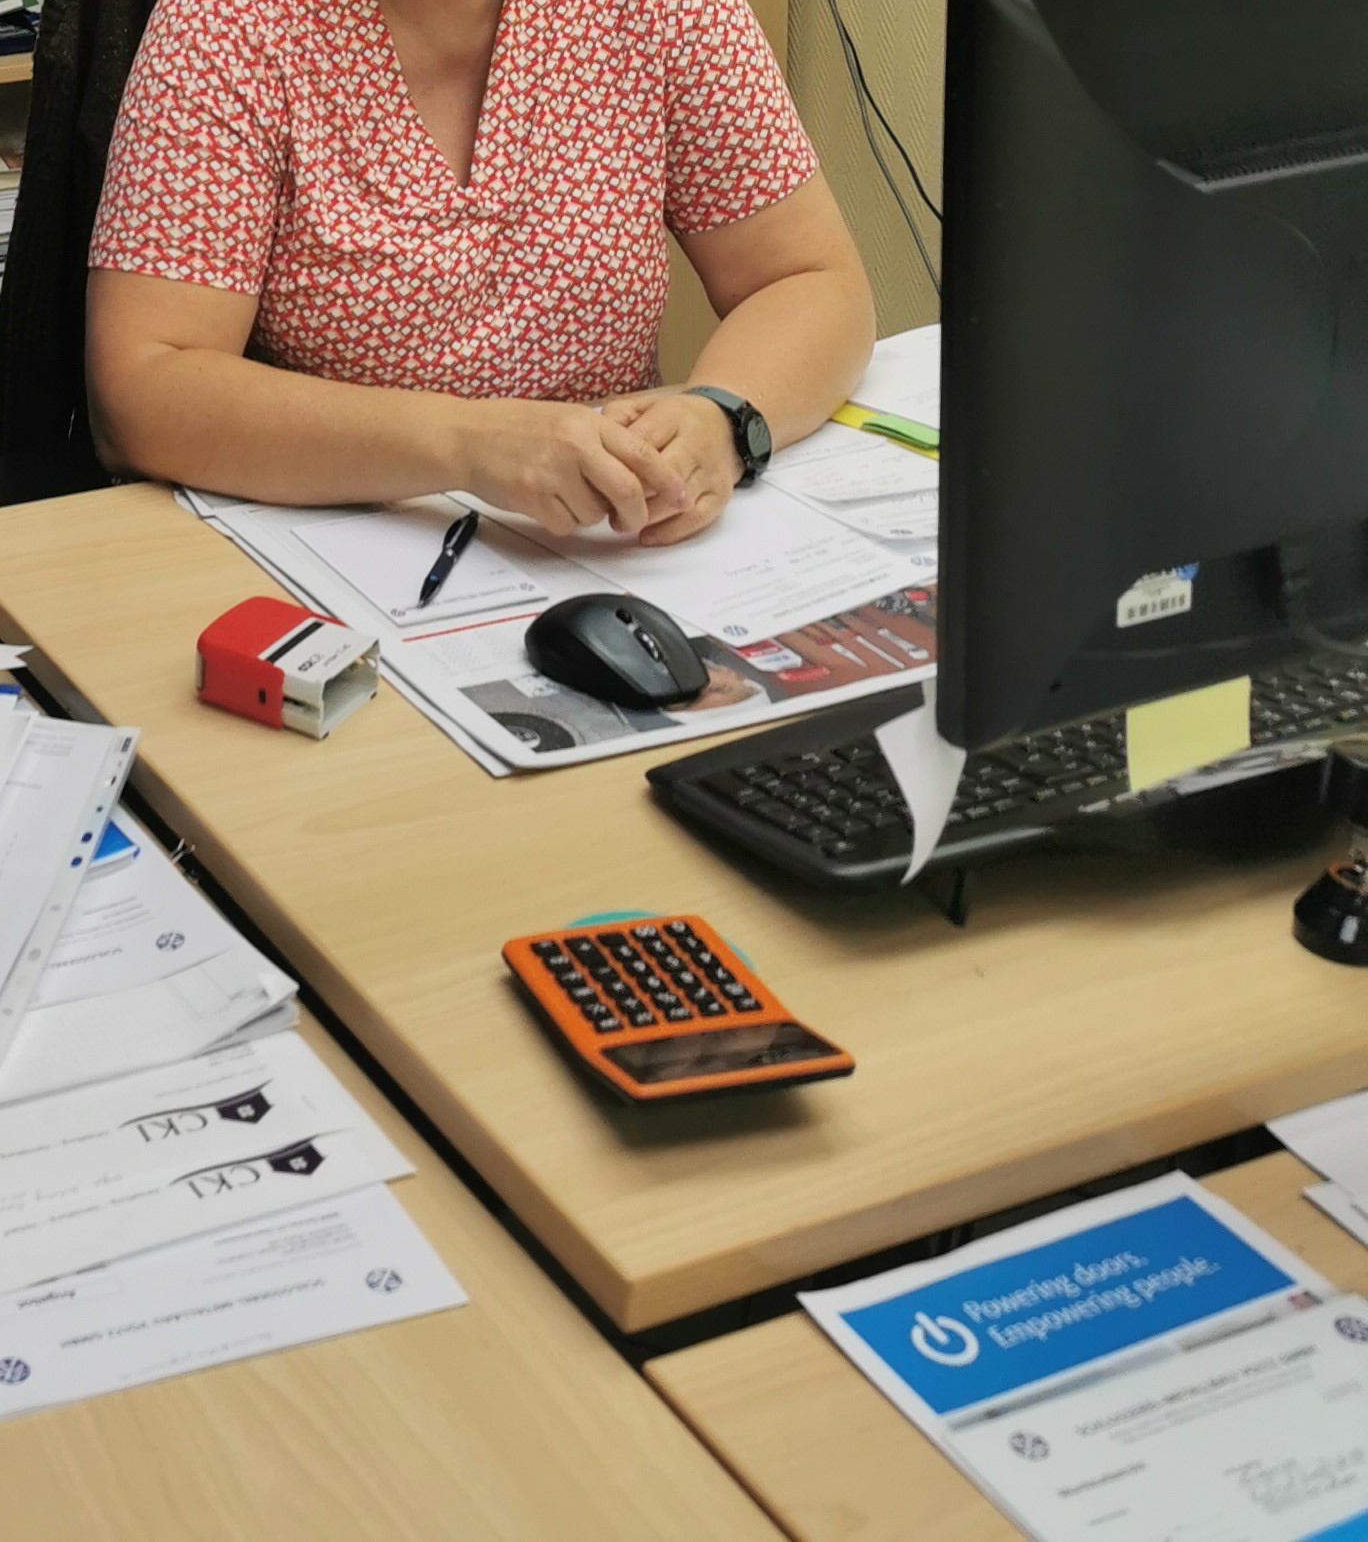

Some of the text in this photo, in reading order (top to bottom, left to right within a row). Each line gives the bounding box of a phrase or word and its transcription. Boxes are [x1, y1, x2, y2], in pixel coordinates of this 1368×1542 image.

[136, 1112, 208, 1142] CKI
[188, 1164, 260, 1198] CKI
[962, 1251, 1149, 1323] Powering doors.
[987, 1256, 1221, 1349] Empowering people.
